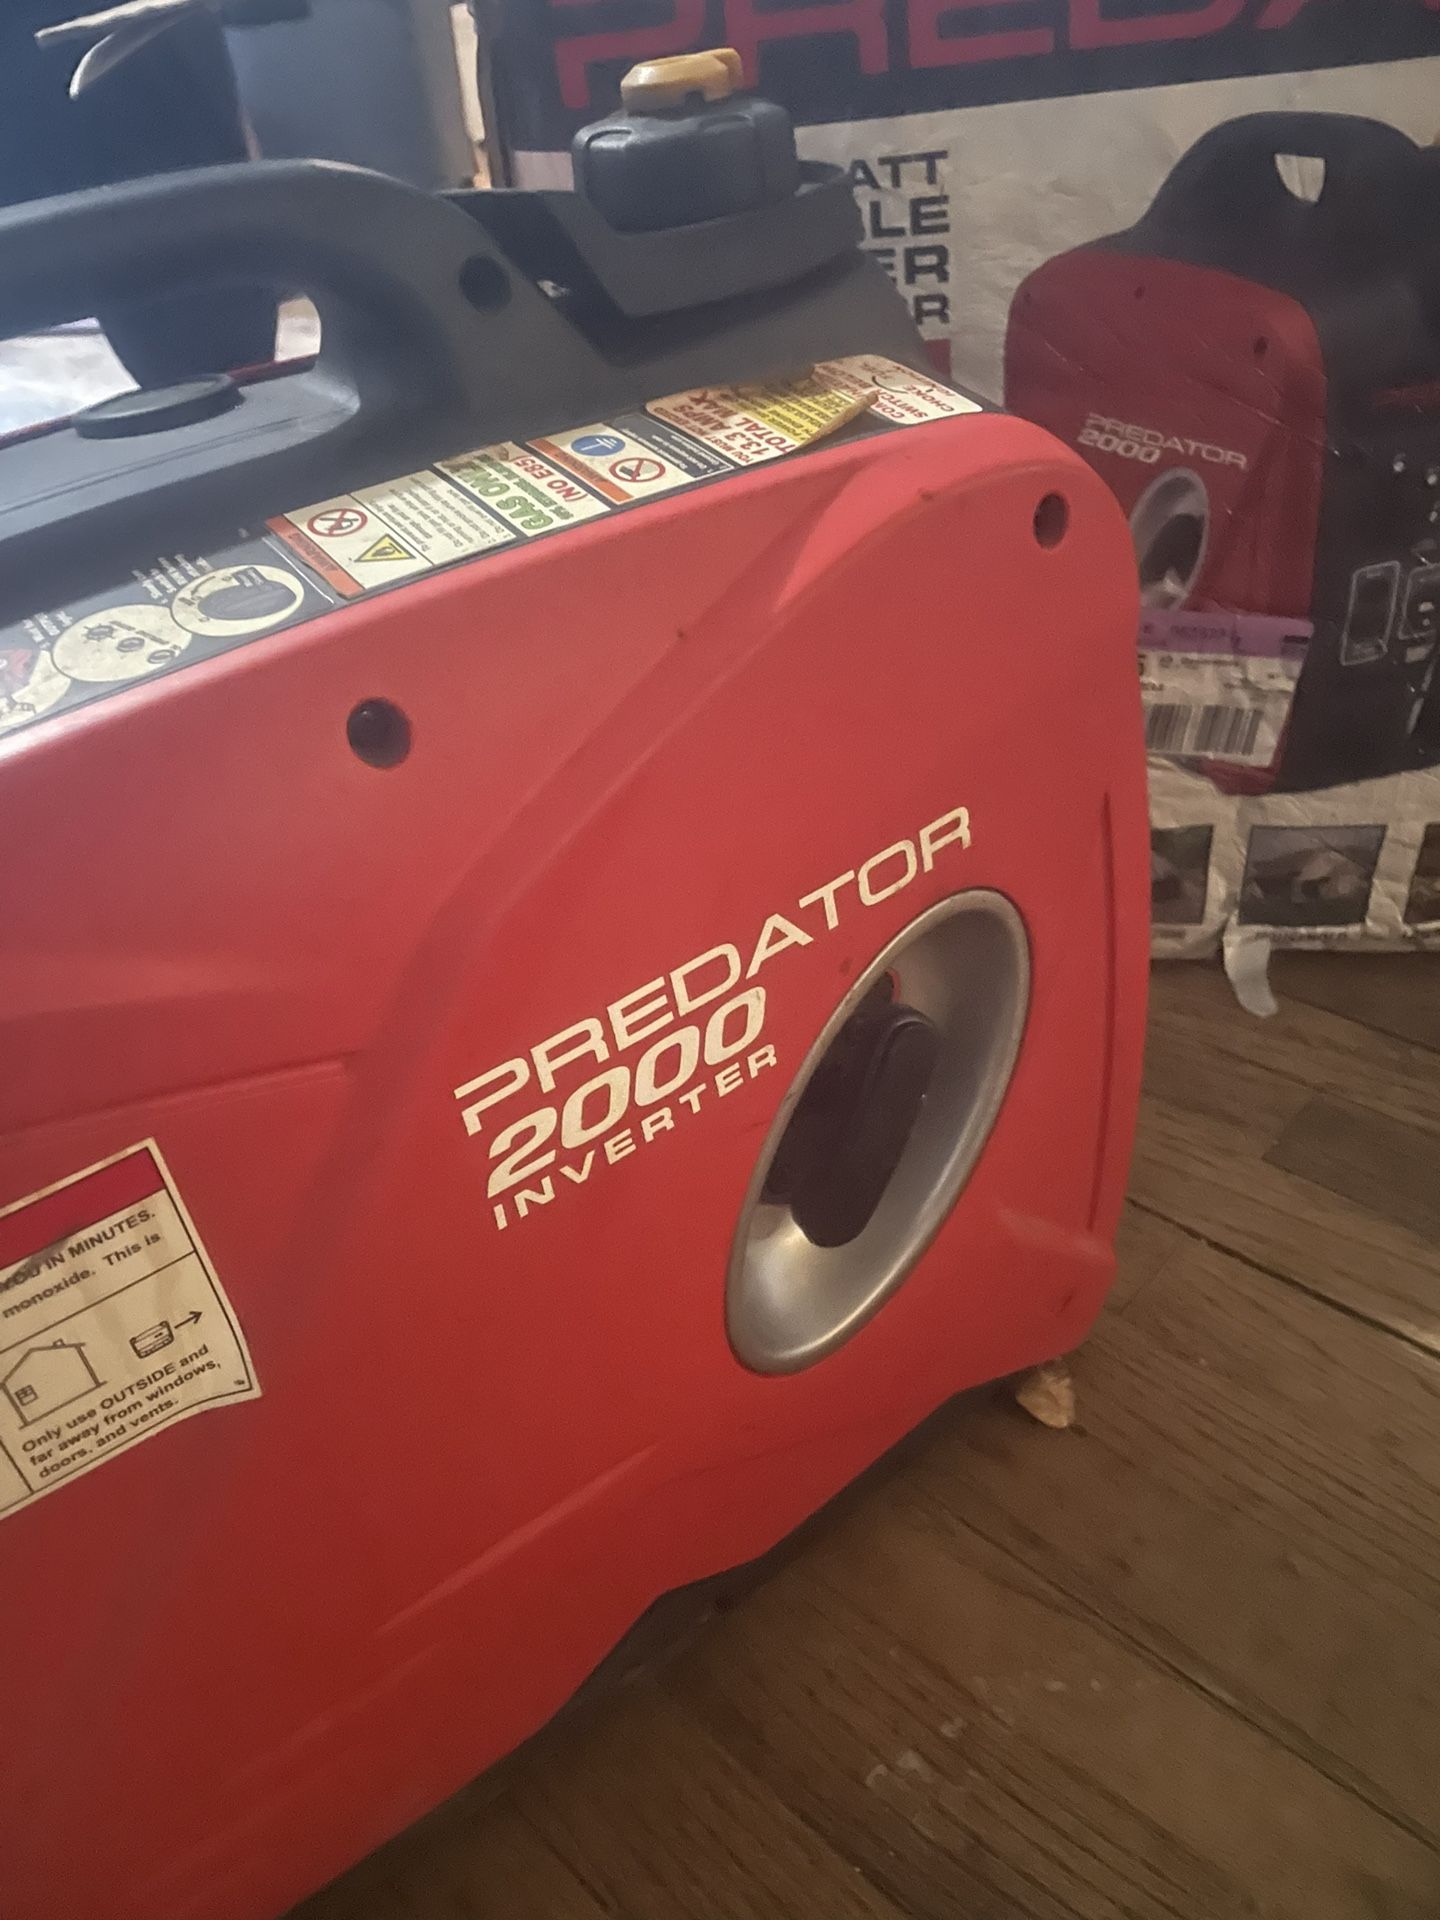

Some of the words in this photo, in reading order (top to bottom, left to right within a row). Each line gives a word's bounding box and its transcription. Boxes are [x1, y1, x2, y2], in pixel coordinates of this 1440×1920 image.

[850, 151, 948, 189] ATT
[869, 195, 949, 237] LE
[671, 400, 731, 433] AMPS
[683, 390, 739, 420] MAX
[721, 430, 774, 456] 13.3
[730, 415, 800, 453] TOTAL
[1077, 428, 1161, 464] 2000
[1083, 412, 1249, 471] PREDATOR
[509, 453, 557, 480] E85)
[542, 477, 589, 503] (NO
[491, 493, 558, 532] GAS
[453, 807, 971, 1135] PREDATOR
[487, 986, 766, 1198] 2000
[492, 1044, 777, 1230] INVERTER
[48, 1252, 65, 1271] IN
[69, 1209, 156, 1261] MINUTES.
[3, 1270, 96, 1319] monoxide.
[103, 1243, 142, 1267] This
[146, 1232, 160, 1247] is
[21, 1424, 61, 1453] Only
[67, 1407, 97, 1426] use
[101, 1364, 176, 1410] OUTSIDE
[179, 1344, 209, 1367] and
[29, 1446, 53, 1466] far
[58, 1426, 100, 1454] away
[103, 1399, 142, 1426] from
[146, 1362, 222, 1403] windows,
[39, 1450, 93, 1478] doors,
[96, 1424, 127, 1447] and
[130, 1399, 178, 1427] vents.
